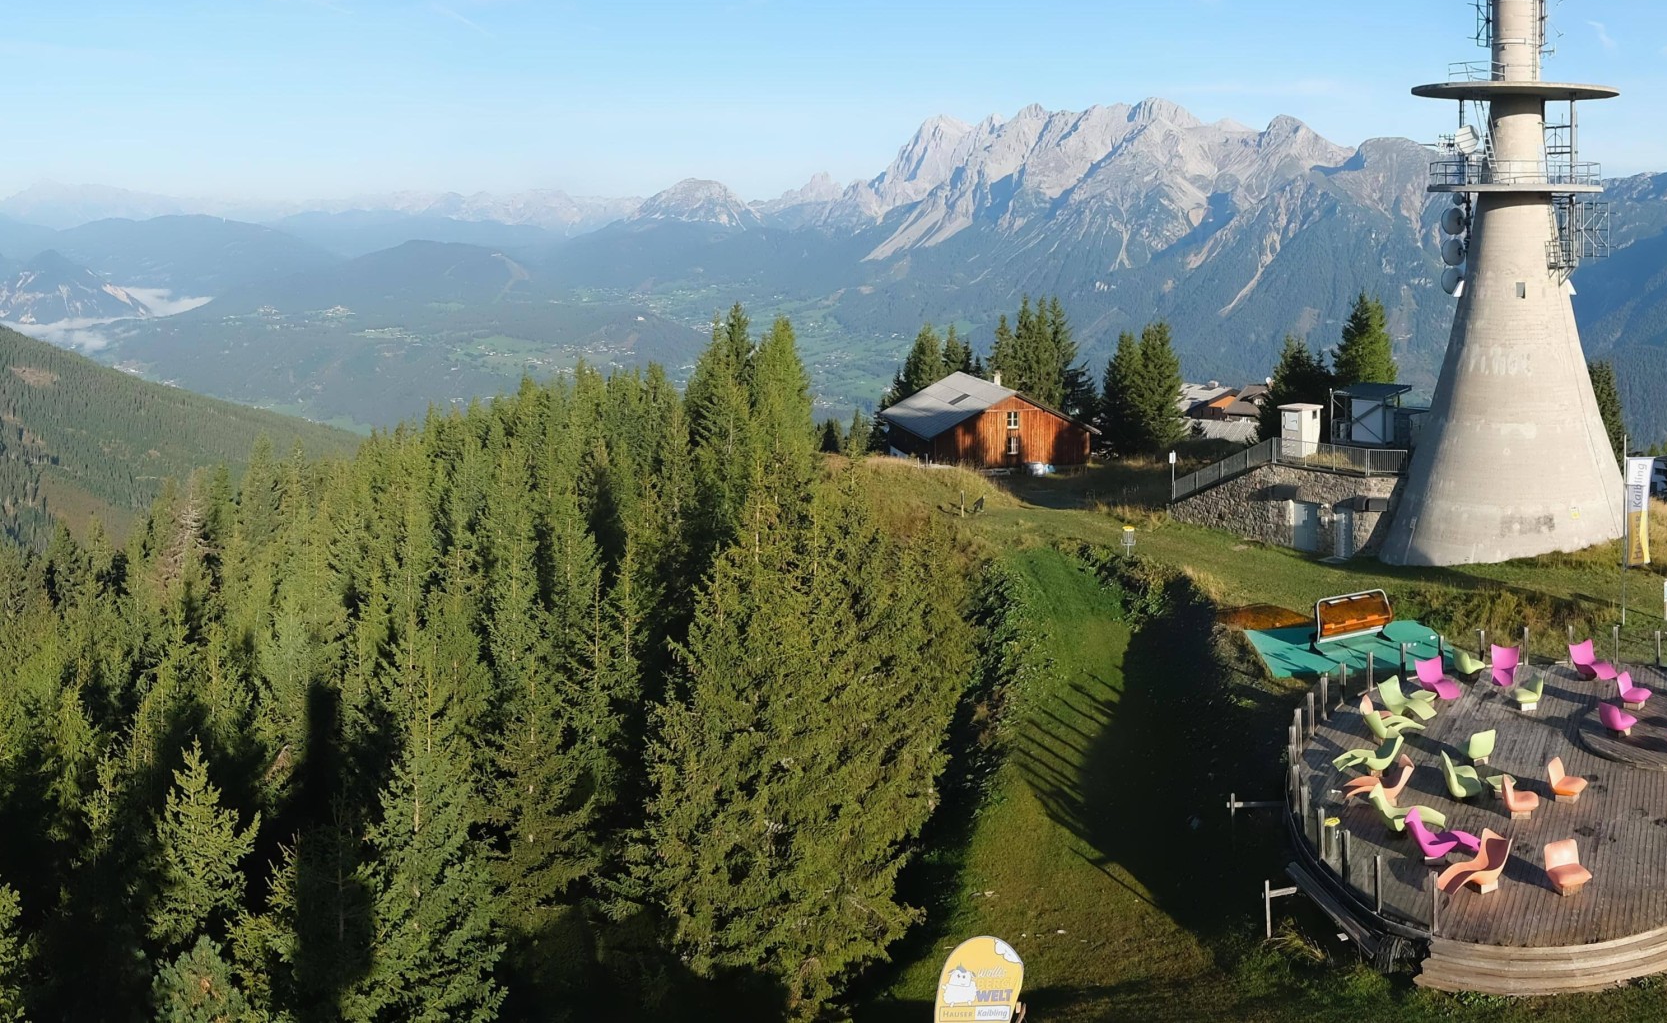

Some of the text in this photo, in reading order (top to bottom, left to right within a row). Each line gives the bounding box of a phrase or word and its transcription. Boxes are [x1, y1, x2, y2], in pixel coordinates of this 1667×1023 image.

[975, 989, 1013, 1002] WELT
[942, 1008, 1008, 1019] HAUSER Kaibling
